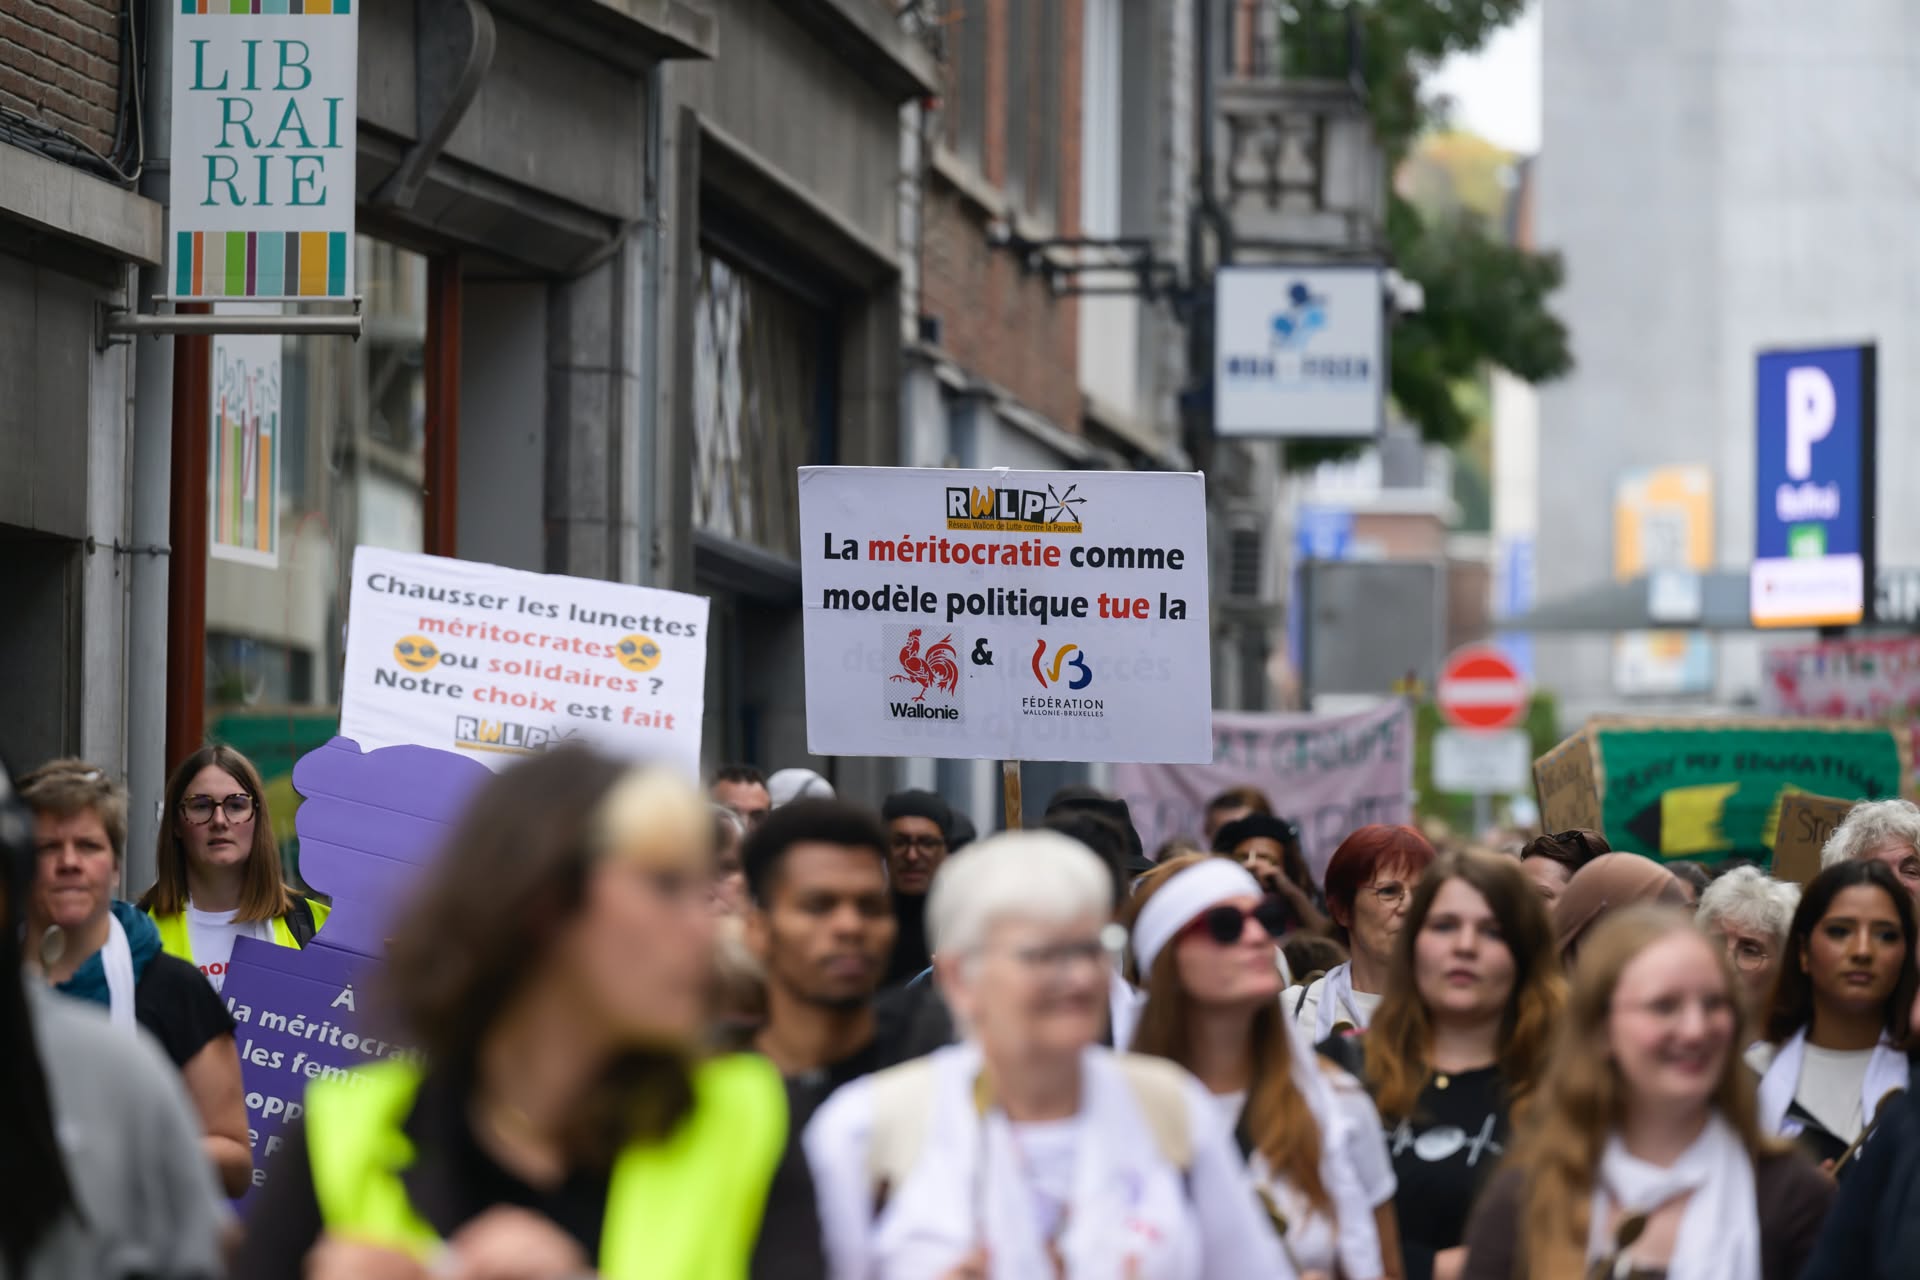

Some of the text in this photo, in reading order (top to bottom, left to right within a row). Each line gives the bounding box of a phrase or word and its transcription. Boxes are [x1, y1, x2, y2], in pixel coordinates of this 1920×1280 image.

[189, 39, 312, 91] LIB
[214, 97, 344, 149] RAI
[200, 154, 328, 206] RIE
[1786, 366, 1836, 480] P
[946, 485, 1046, 523] RWLP
[948, 520, 1082, 532] Réseau Wallon de Lutte contre la Pauvreté
[824, 532, 1185, 570] La méritocratie comme
[366, 574, 697, 638] Chausser les lunettes
[822, 584, 1187, 626] modèle politique tue la
[417, 615, 616, 659] méritocrates
[971, 637, 994, 666] &
[439, 650, 664, 696] ou solidaires ?
[374, 667, 676, 731] Notre choix est fait
[889, 702, 959, 720] Wallonie
[1022, 696, 1104, 709] FÉDÉRATION
[1022, 709, 1104, 718] WALLONIE-BRUXELLES
[456, 715, 549, 750] RWLP
[226, 996, 252, 1023] la
[330, 984, 356, 1012] À
[241, 1038, 285, 1070] les
